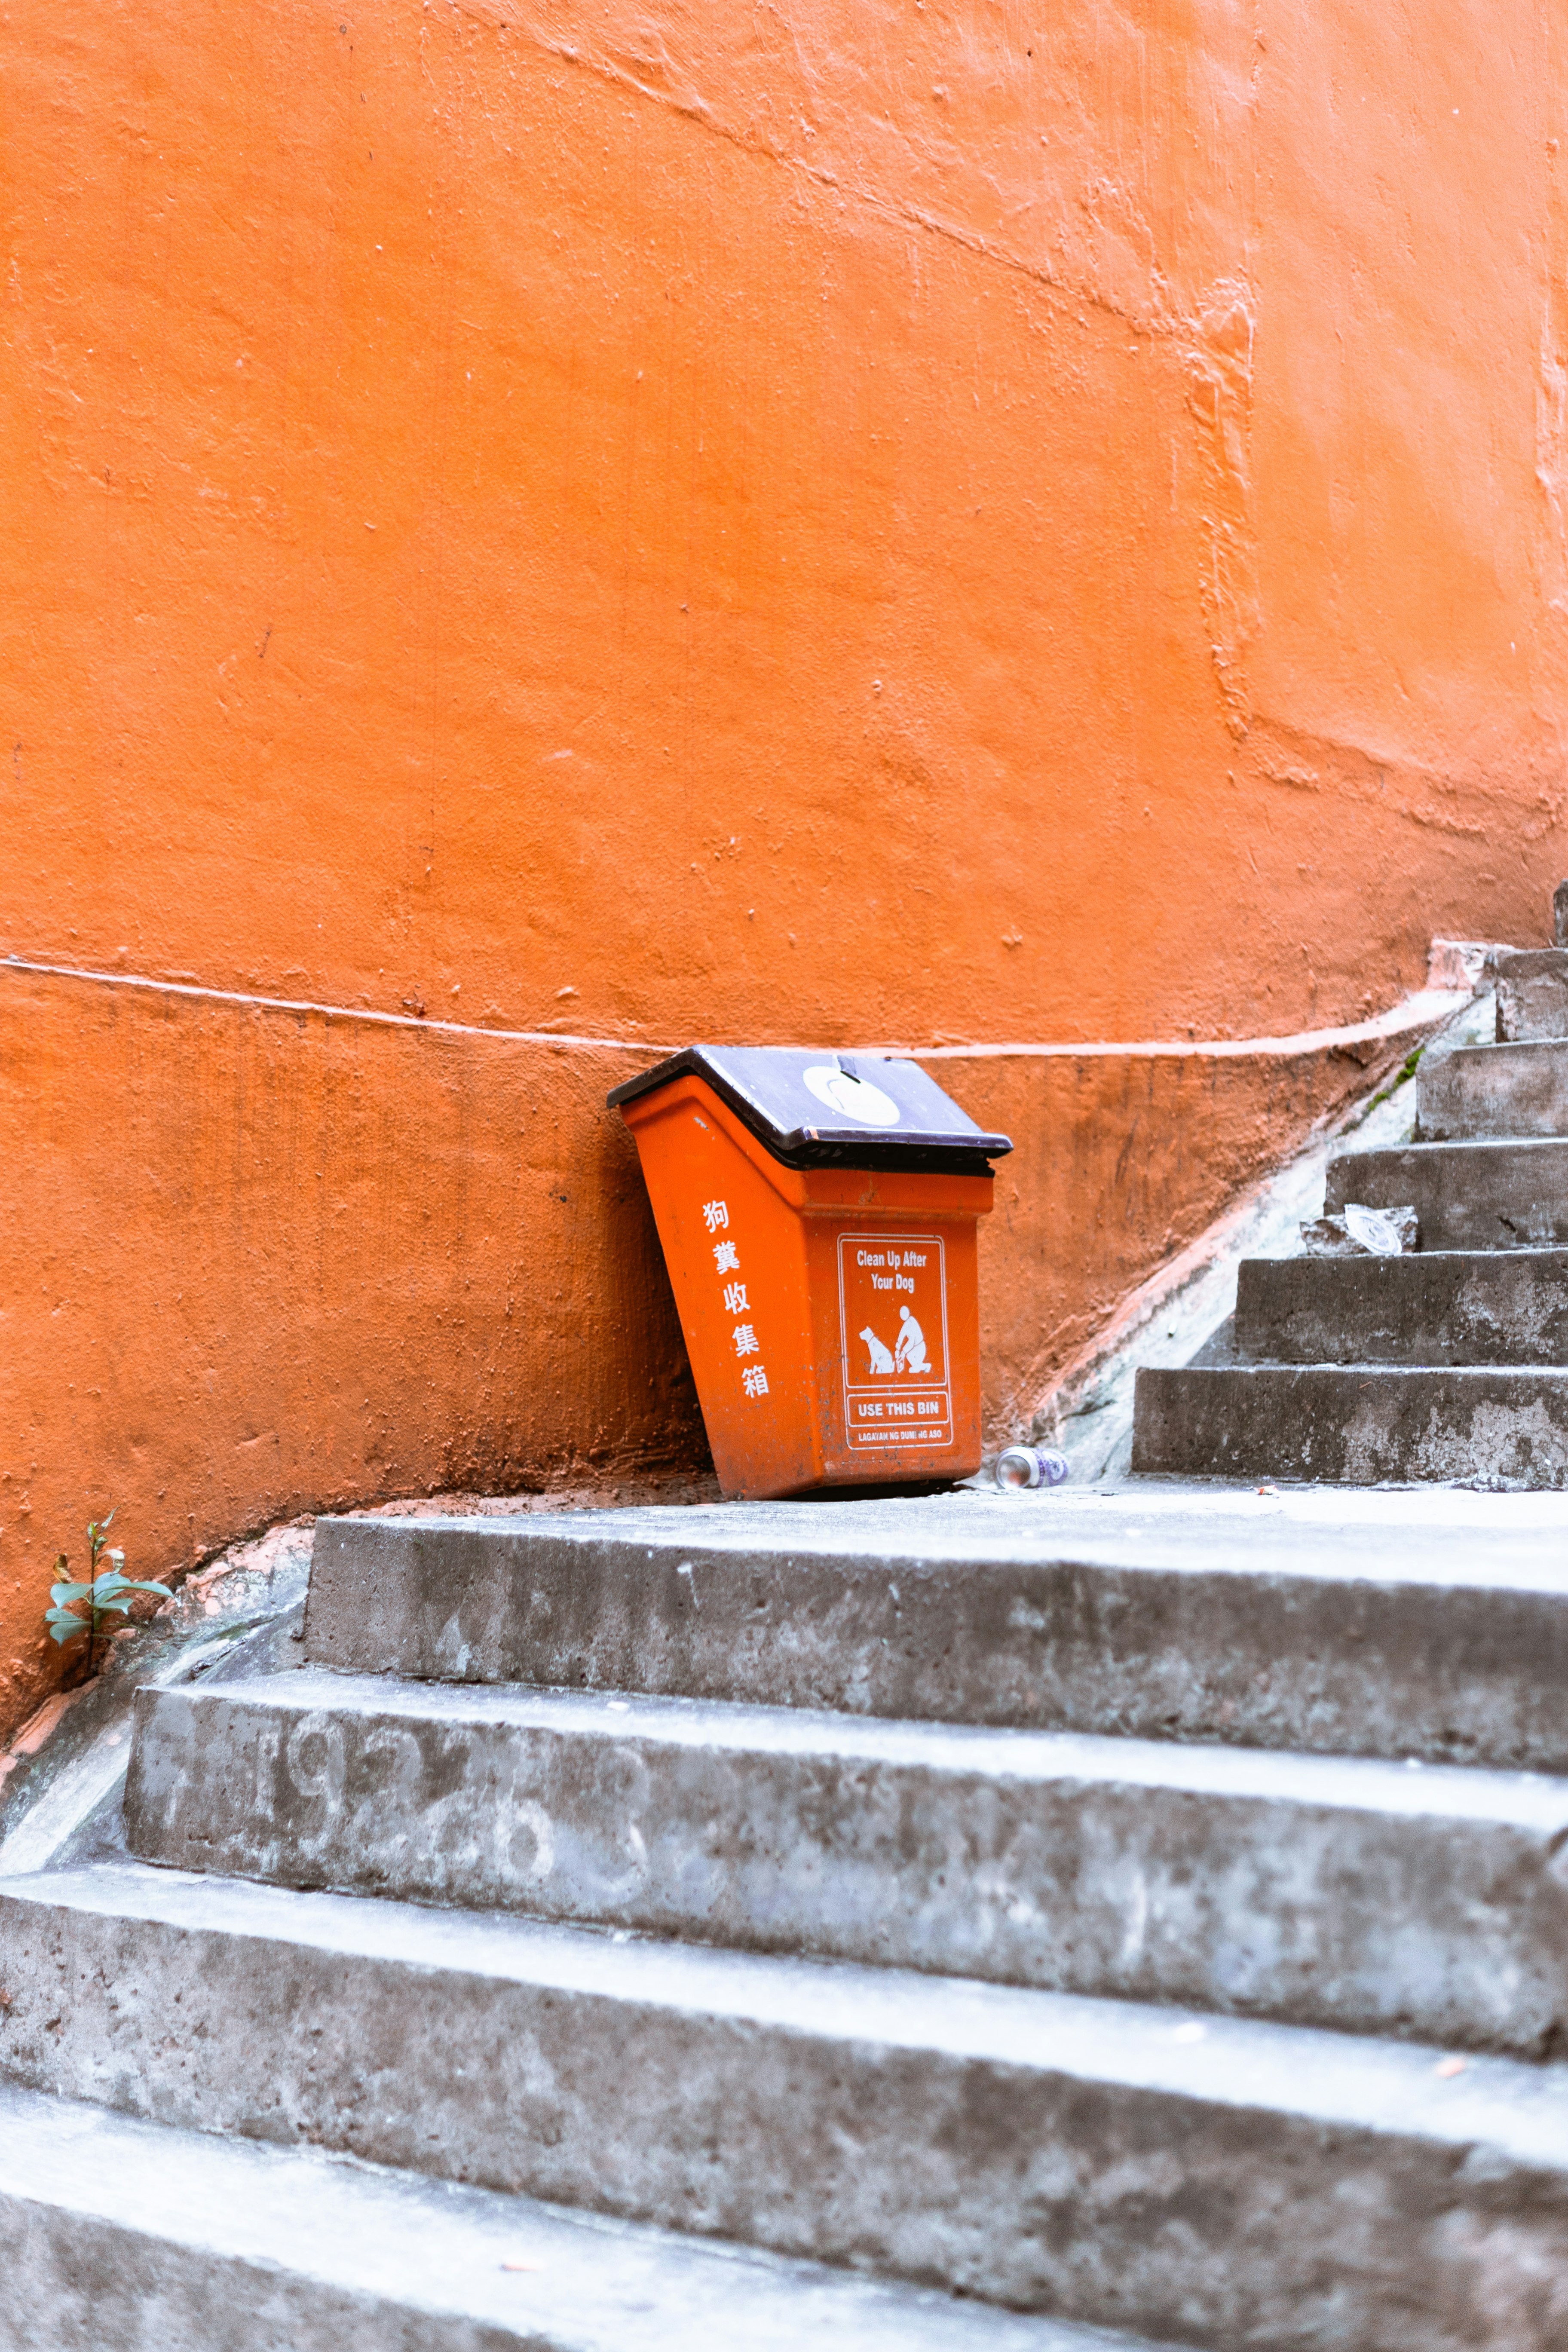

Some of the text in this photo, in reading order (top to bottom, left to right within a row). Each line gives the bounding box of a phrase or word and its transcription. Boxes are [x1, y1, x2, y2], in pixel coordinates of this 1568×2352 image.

[857, 1250, 926, 1270] Clean Up After
[871, 1274, 914, 1293] Your Dog
[702, 1200, 769, 1398] 狗糞收集箱
[858, 1401, 939, 1416] USE THIS BIN
[858, 1429, 942, 1441] LAGAYAN NG DUMI NG ASO
